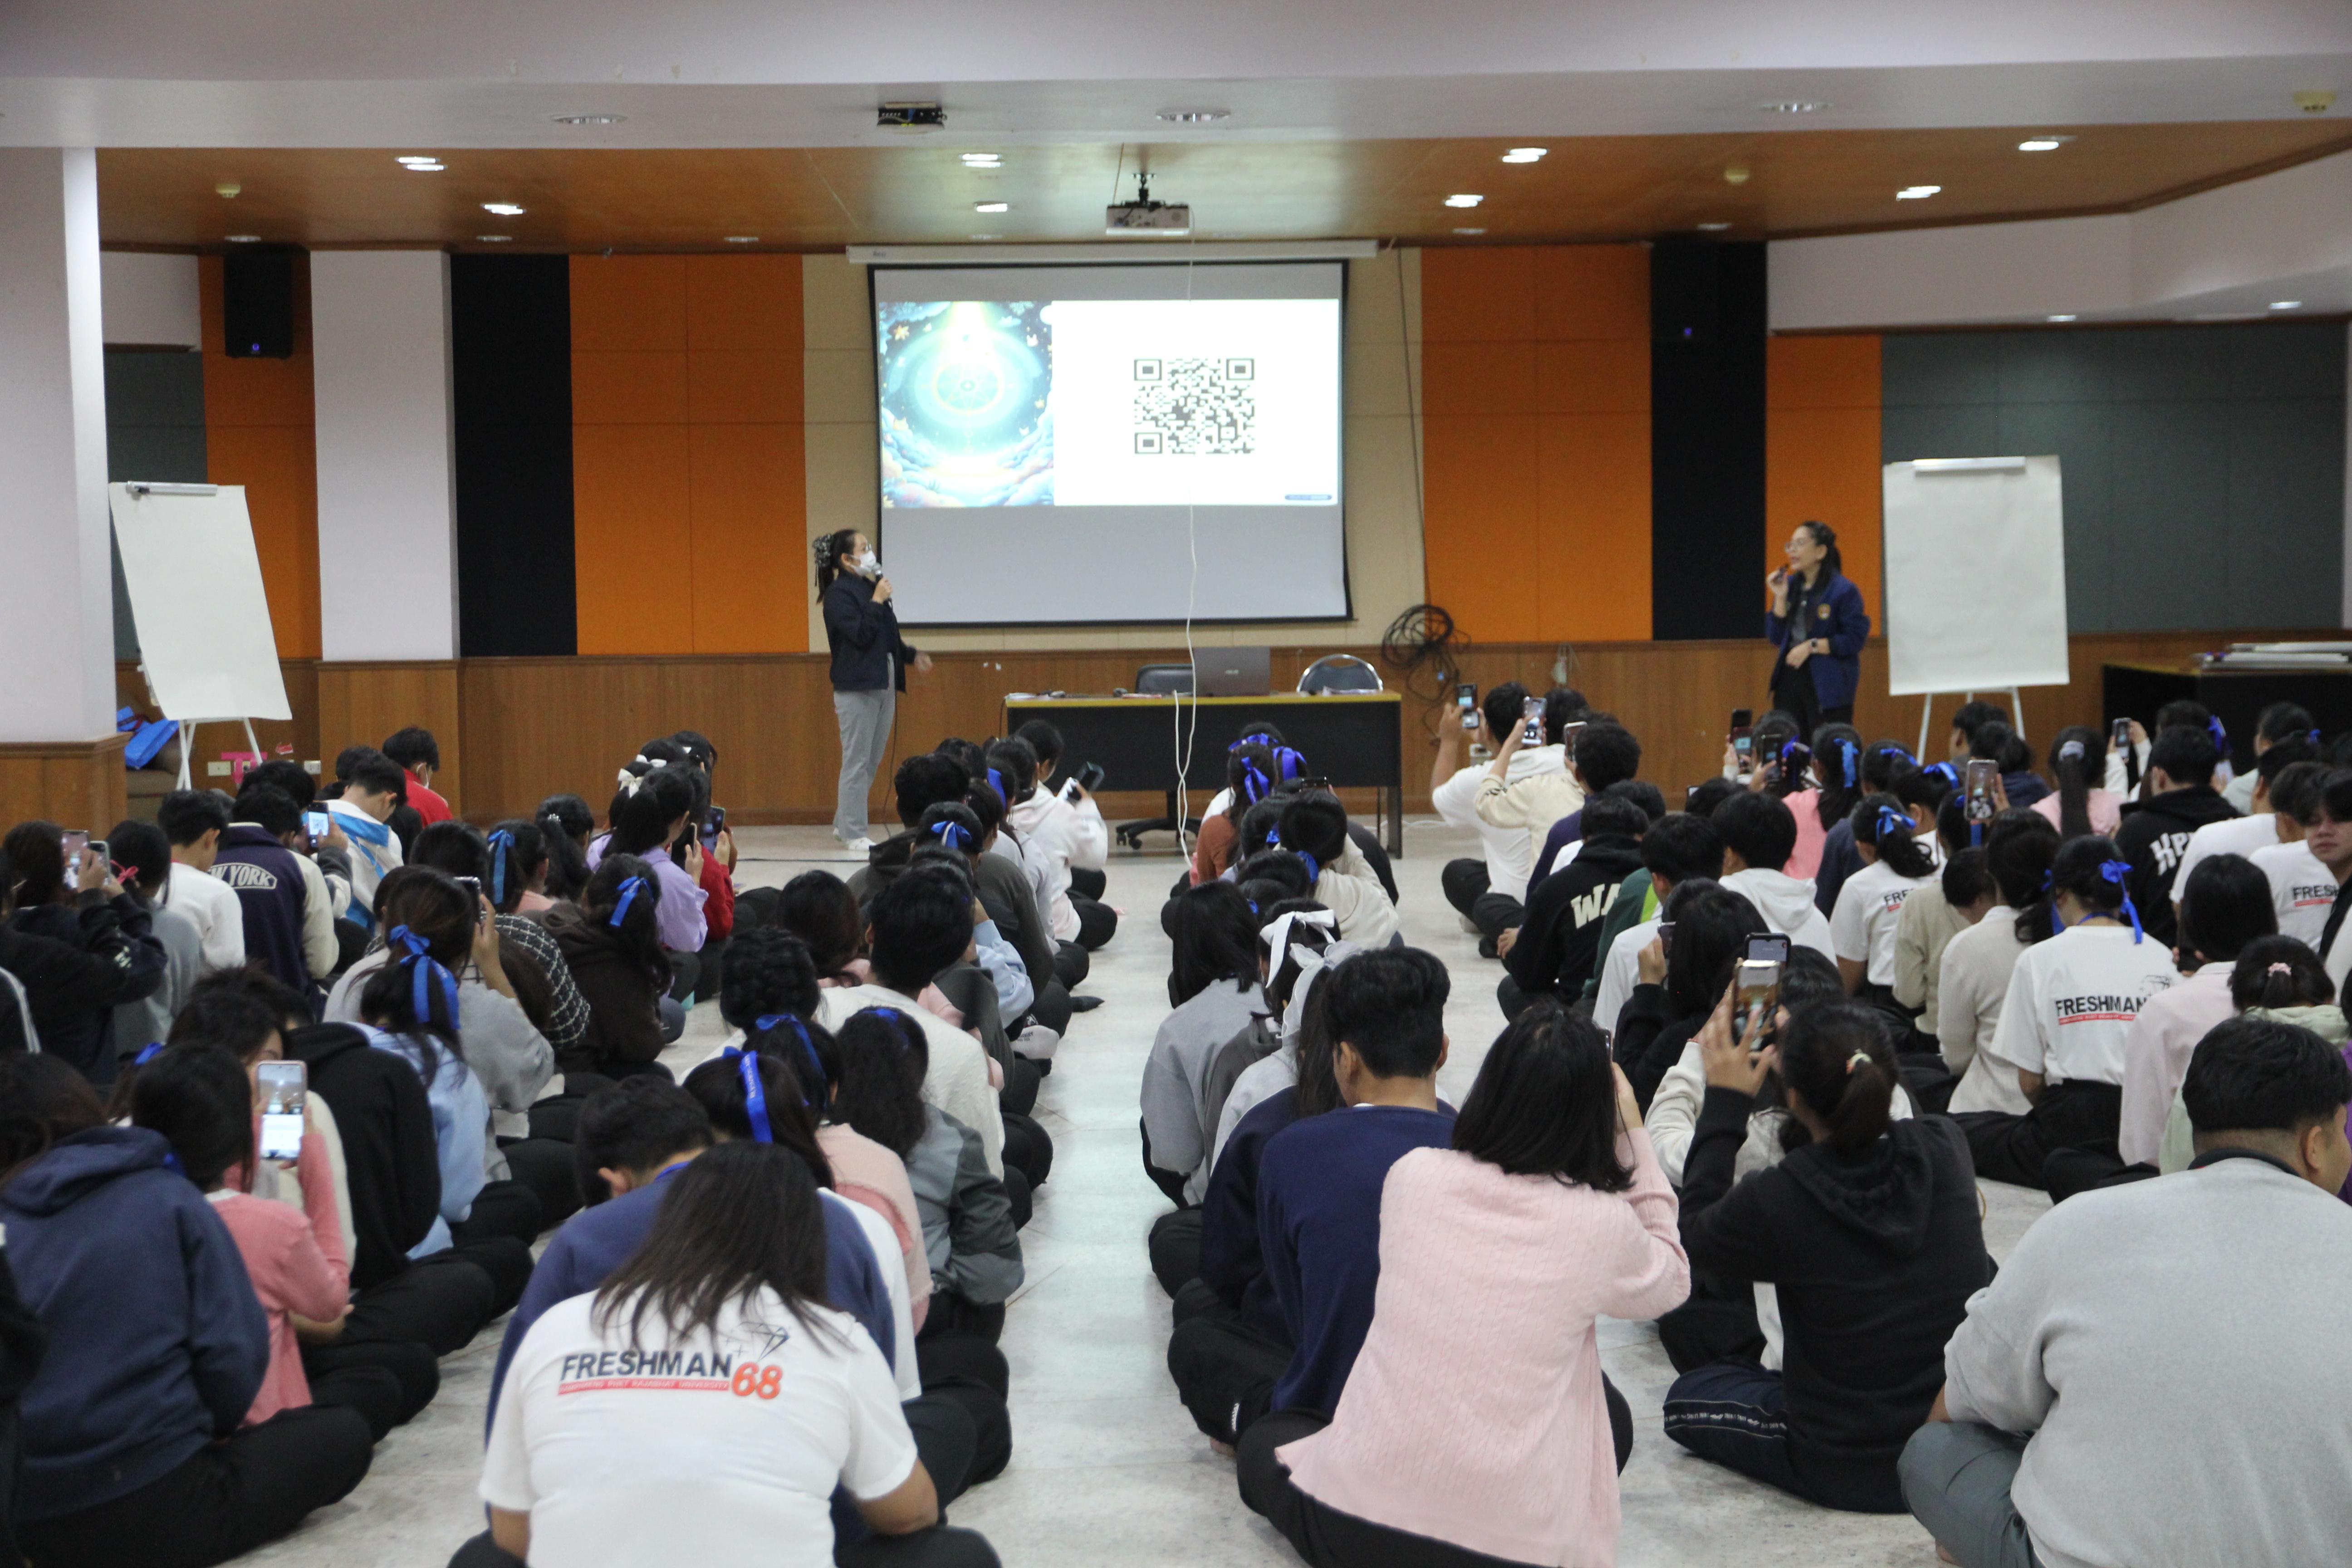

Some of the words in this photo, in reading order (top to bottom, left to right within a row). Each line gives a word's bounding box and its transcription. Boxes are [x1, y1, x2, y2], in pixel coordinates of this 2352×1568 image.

[230, 865, 270, 887] YORK
[2149, 832, 2195, 876] KP
[561, 1350, 733, 1381] FRESHMAN
[731, 1362, 784, 1400] 68
